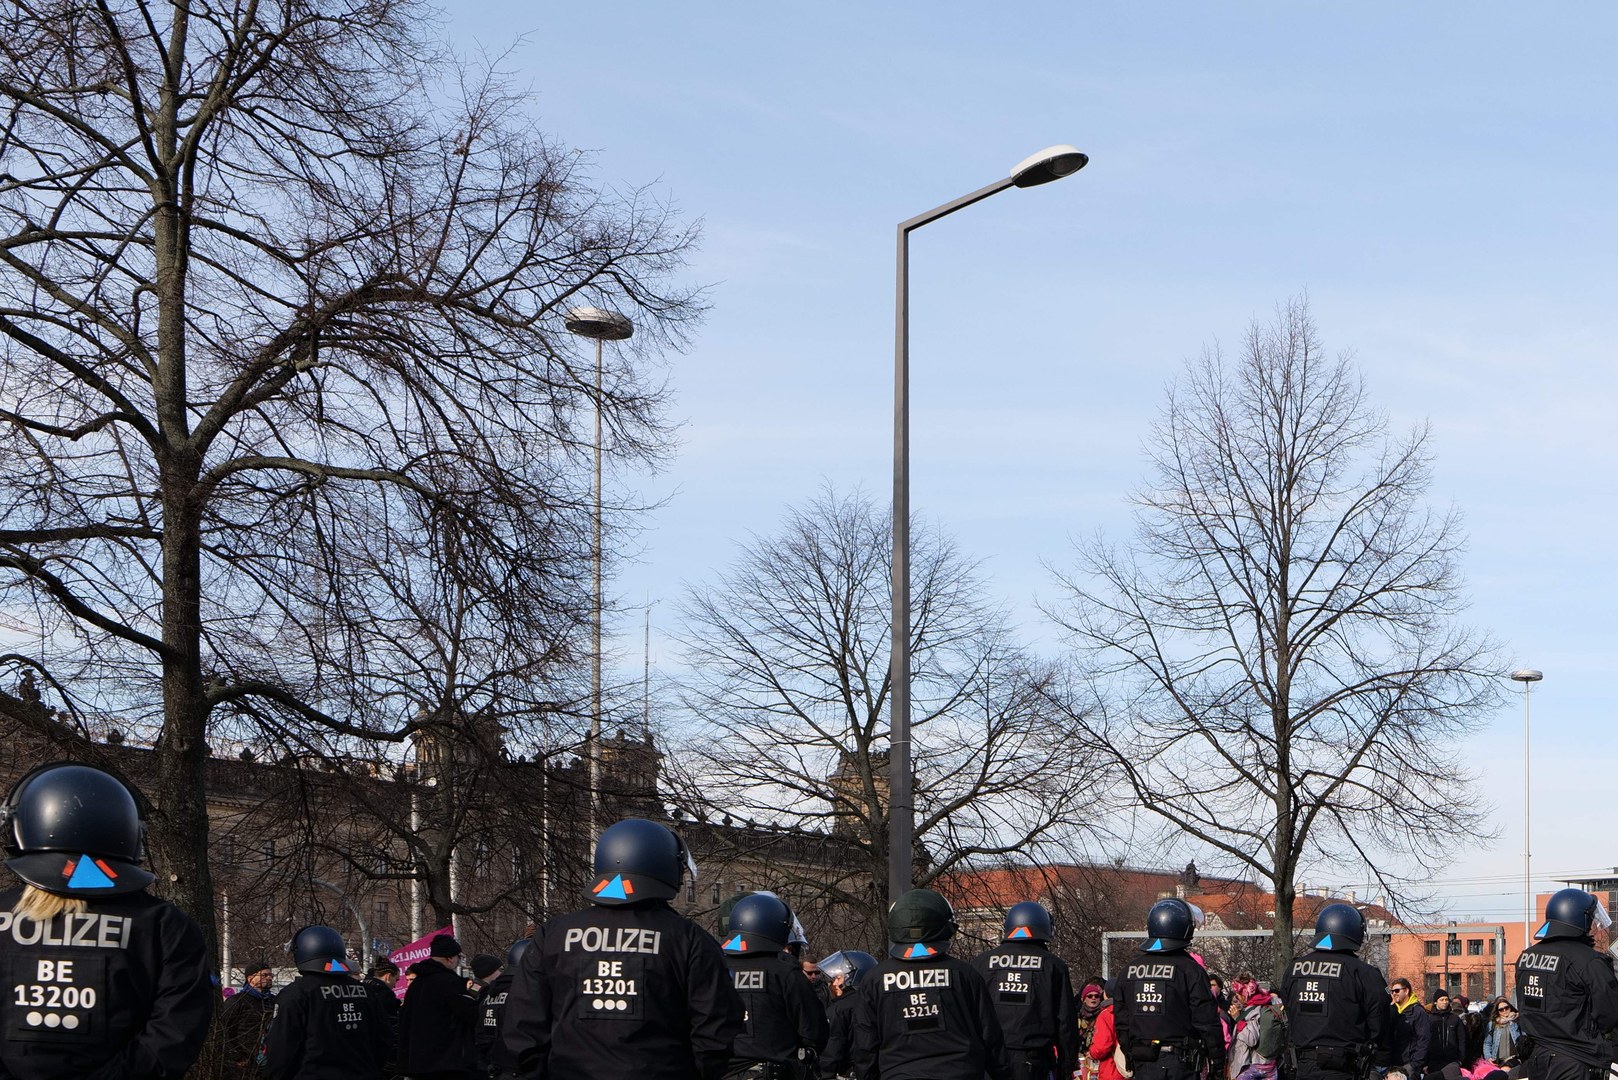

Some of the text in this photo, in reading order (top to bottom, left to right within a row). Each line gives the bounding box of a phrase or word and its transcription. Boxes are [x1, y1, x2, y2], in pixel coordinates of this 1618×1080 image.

[564, 927, 661, 955] POLIZEI
[597, 960, 623, 977] BE
[989, 954, 1042, 970] POLIZEI
[1292, 960, 1342, 978] POLIZEI
[1518, 952, 1560, 972] POLIZEI
[37, 959, 73, 983] BE
[1007, 972, 1021, 983] BE
[1127, 964, 1174, 979] POLIZEI
[883, 968, 949, 991] POLIZEI
[1306, 981, 1319, 991] BE
[1529, 975, 1540, 986] BE
[320, 984, 368, 1000] POLIZEI
[582, 979, 638, 996] 13201
[998, 982, 1029, 993] 13222
[1143, 983, 1156, 993] BE
[1524, 985, 1544, 998] 13121
[13, 984, 97, 1009] 13200
[910, 993, 927, 1006] BE
[1136, 993, 1163, 1003] 13122
[1298, 991, 1325, 1002] 13124
[342, 1003, 355, 1013] BE
[902, 1004, 940, 1019] 13214
[337, 1012, 363, 1023] 13212
